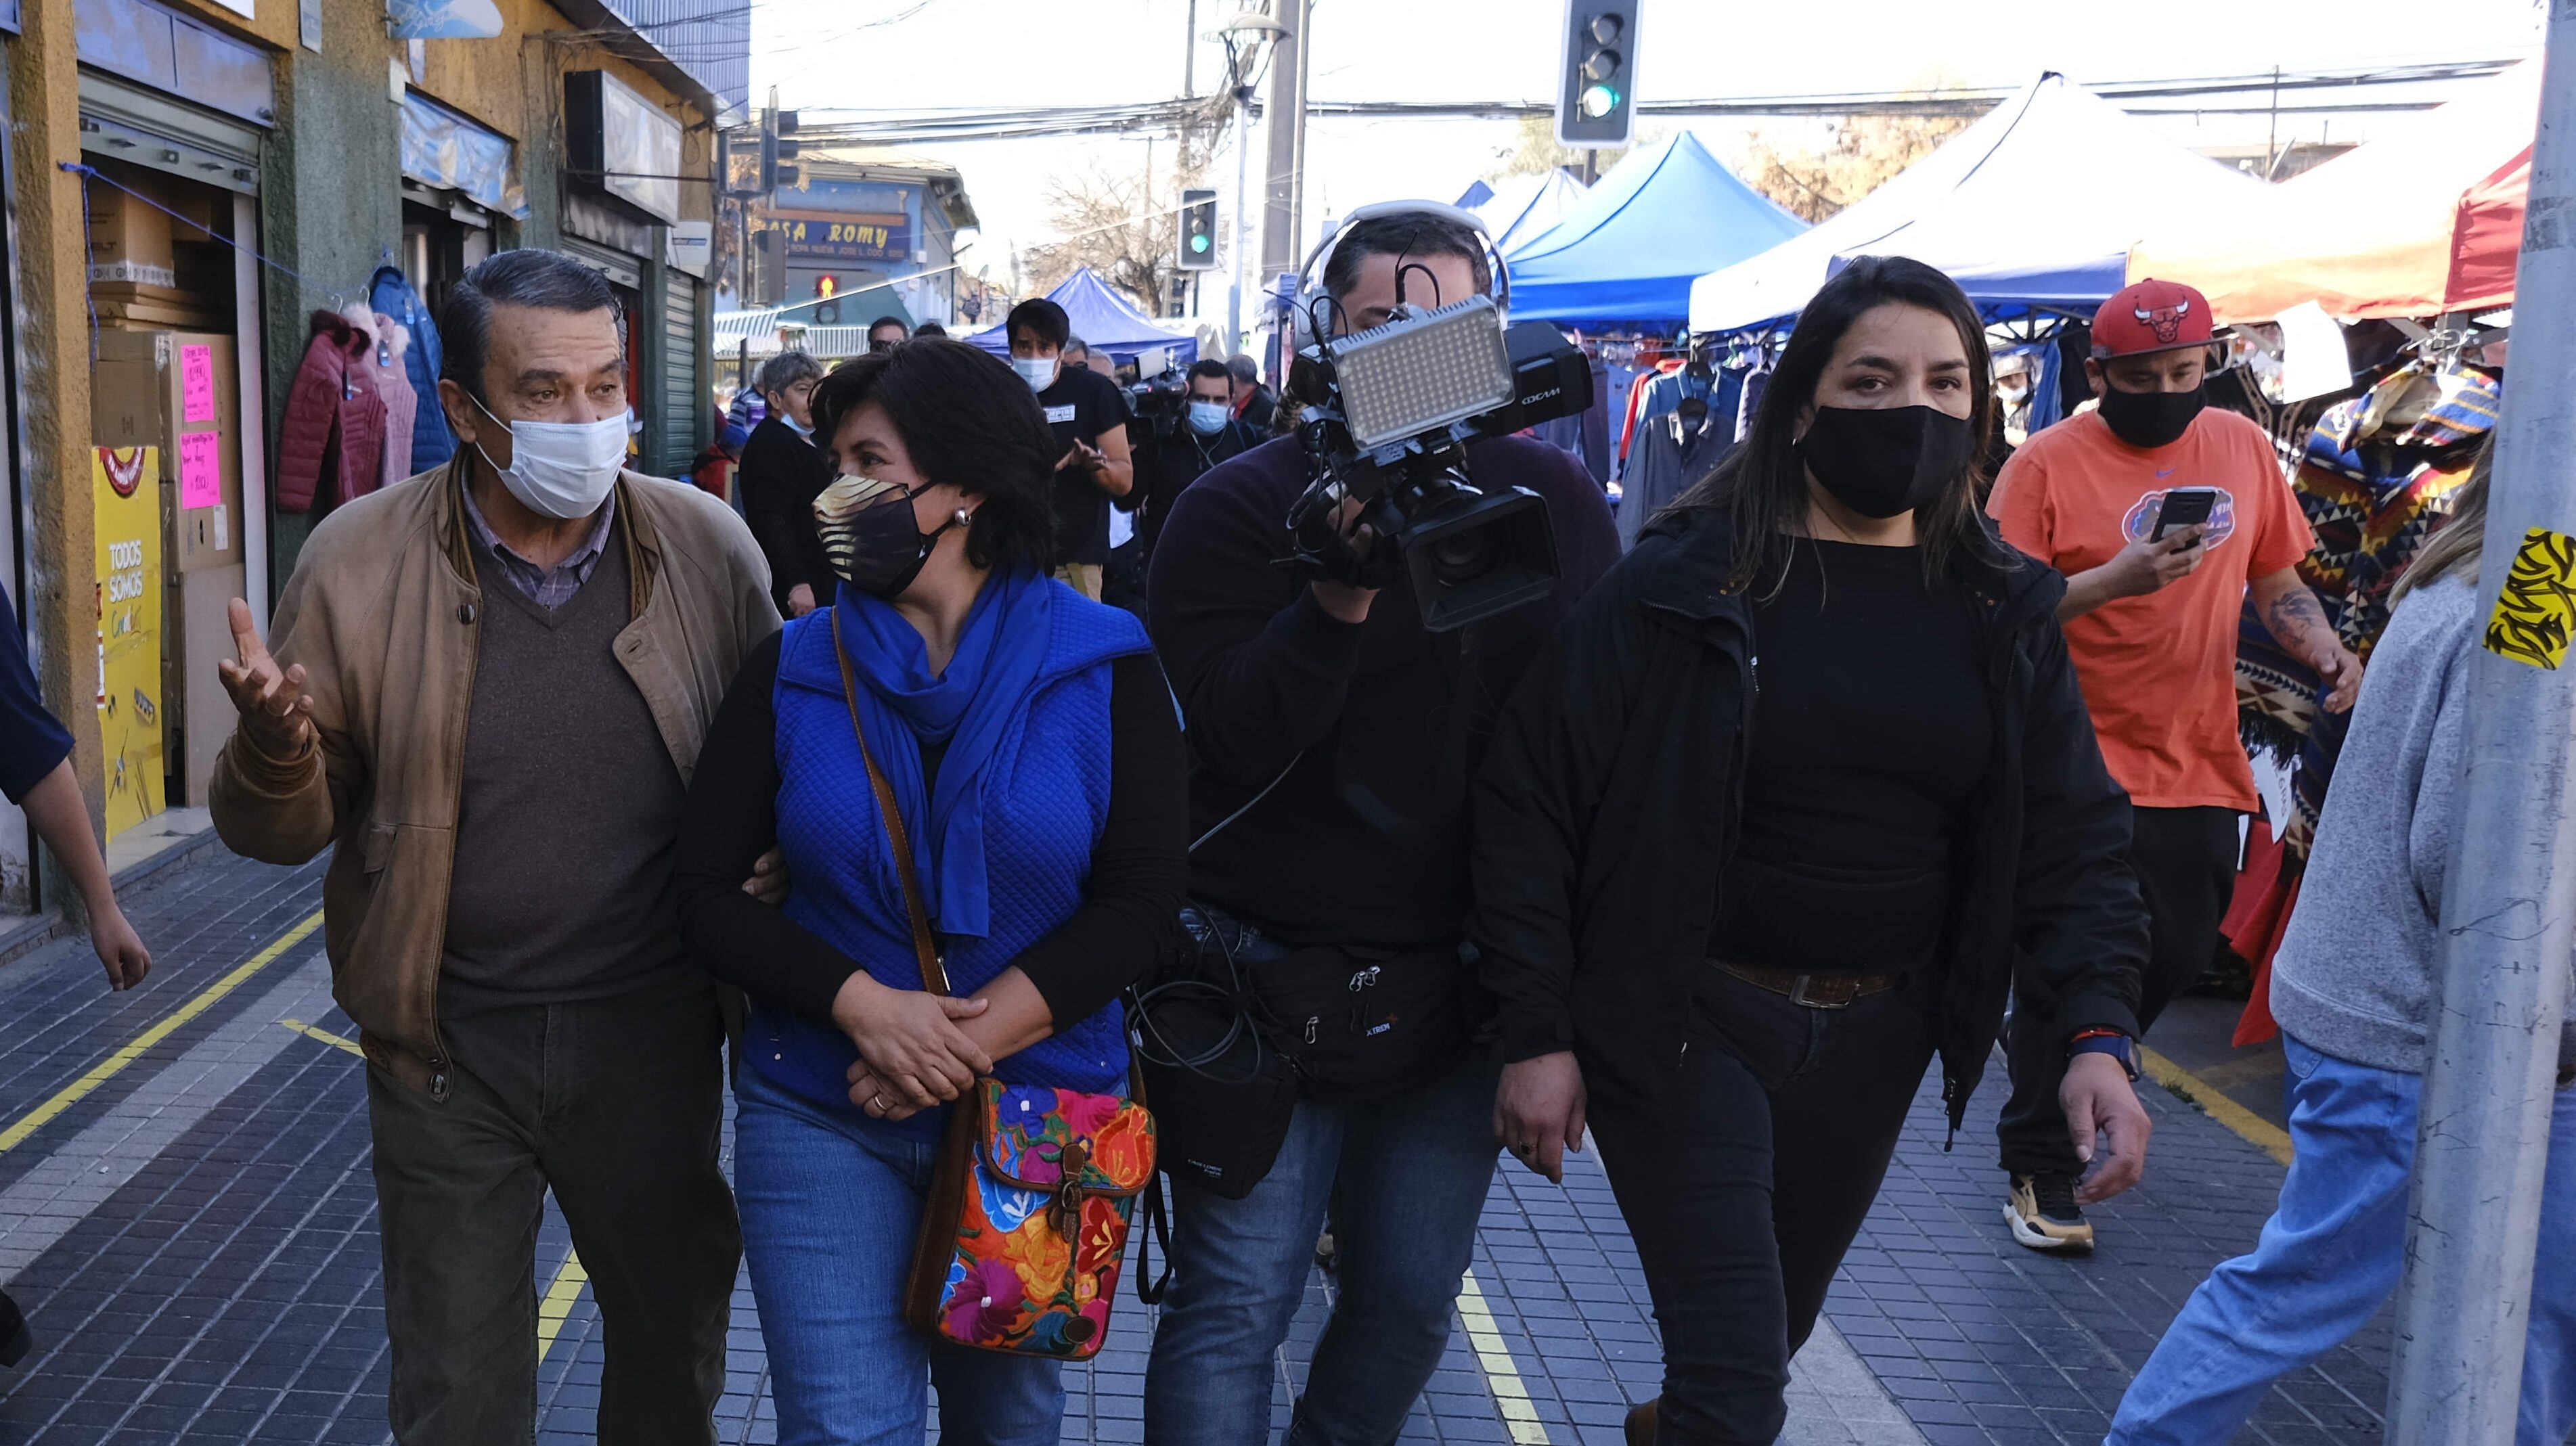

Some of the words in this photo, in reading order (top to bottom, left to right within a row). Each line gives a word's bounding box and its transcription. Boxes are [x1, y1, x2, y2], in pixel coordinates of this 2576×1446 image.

[828, 224, 887, 248] ROMY
[109, 540, 141, 571] TODOS
[110, 571, 143, 604] SOMOS
